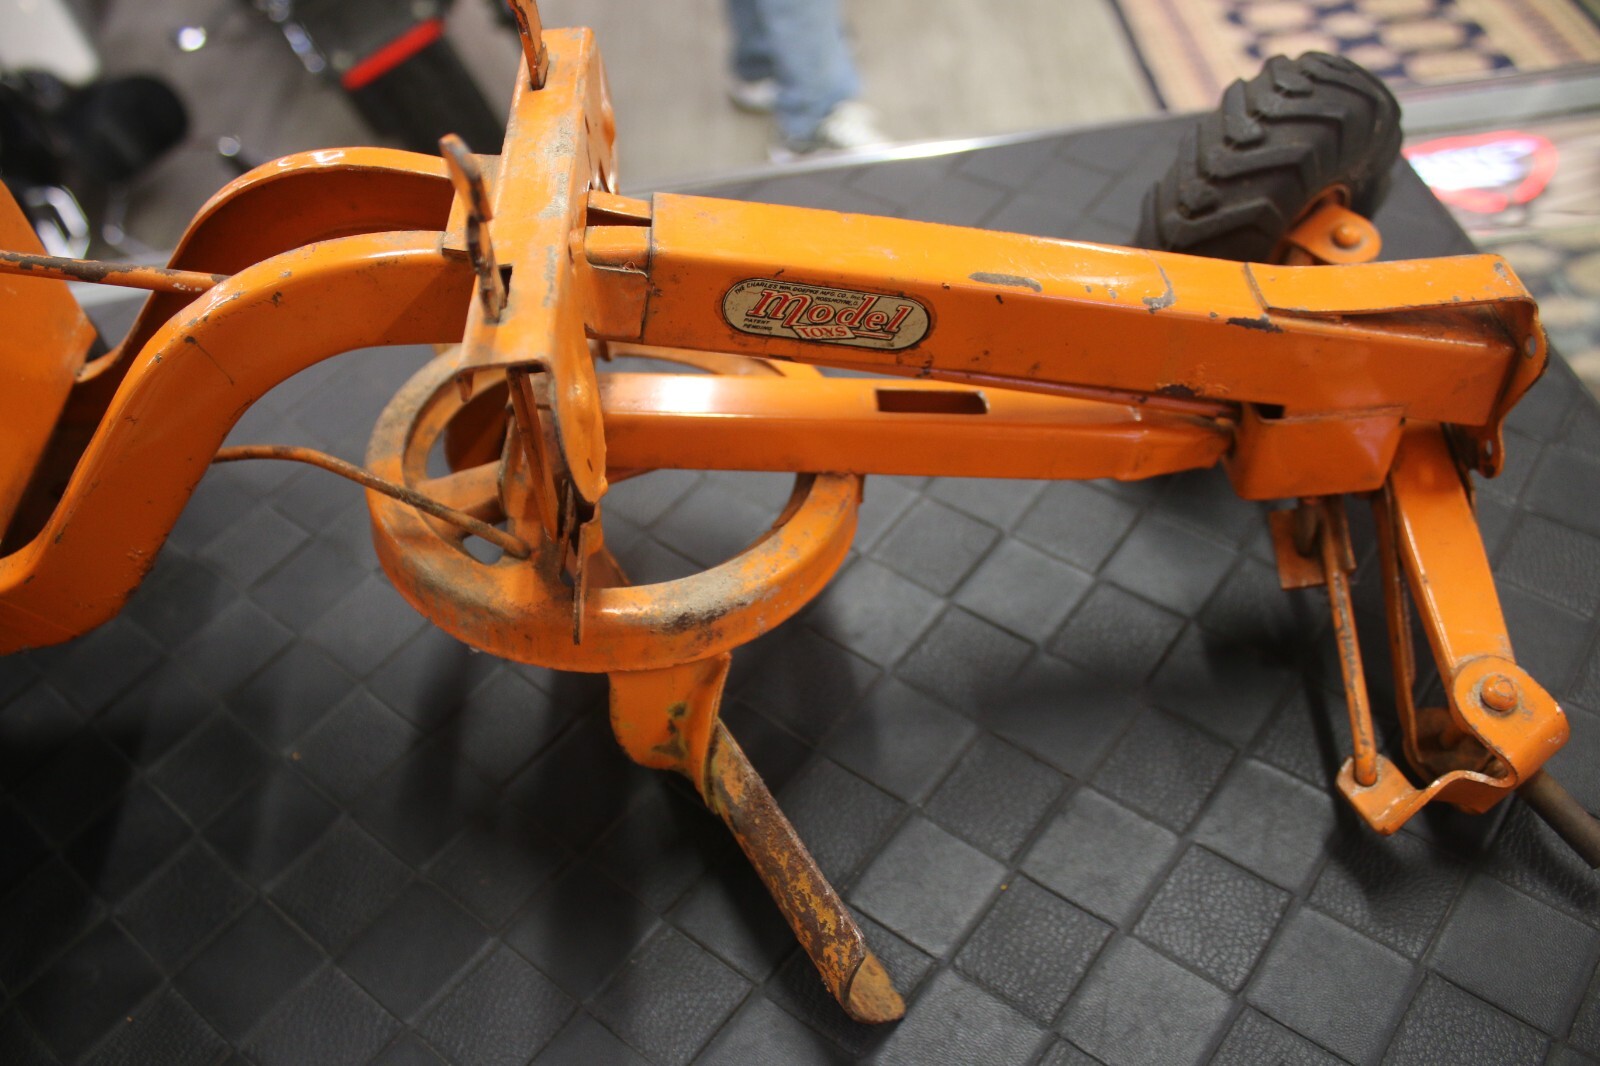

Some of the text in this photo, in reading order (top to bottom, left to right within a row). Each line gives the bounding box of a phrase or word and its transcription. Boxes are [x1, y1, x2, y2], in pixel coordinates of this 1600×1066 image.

[734, 285, 745, 294] THE
[746, 282, 779, 290] CHARLES
[745, 288, 914, 334] Model
[743, 317, 771, 325] PATENT
[743, 323, 773, 331] PENDING
[797, 326, 848, 338] TOYS
